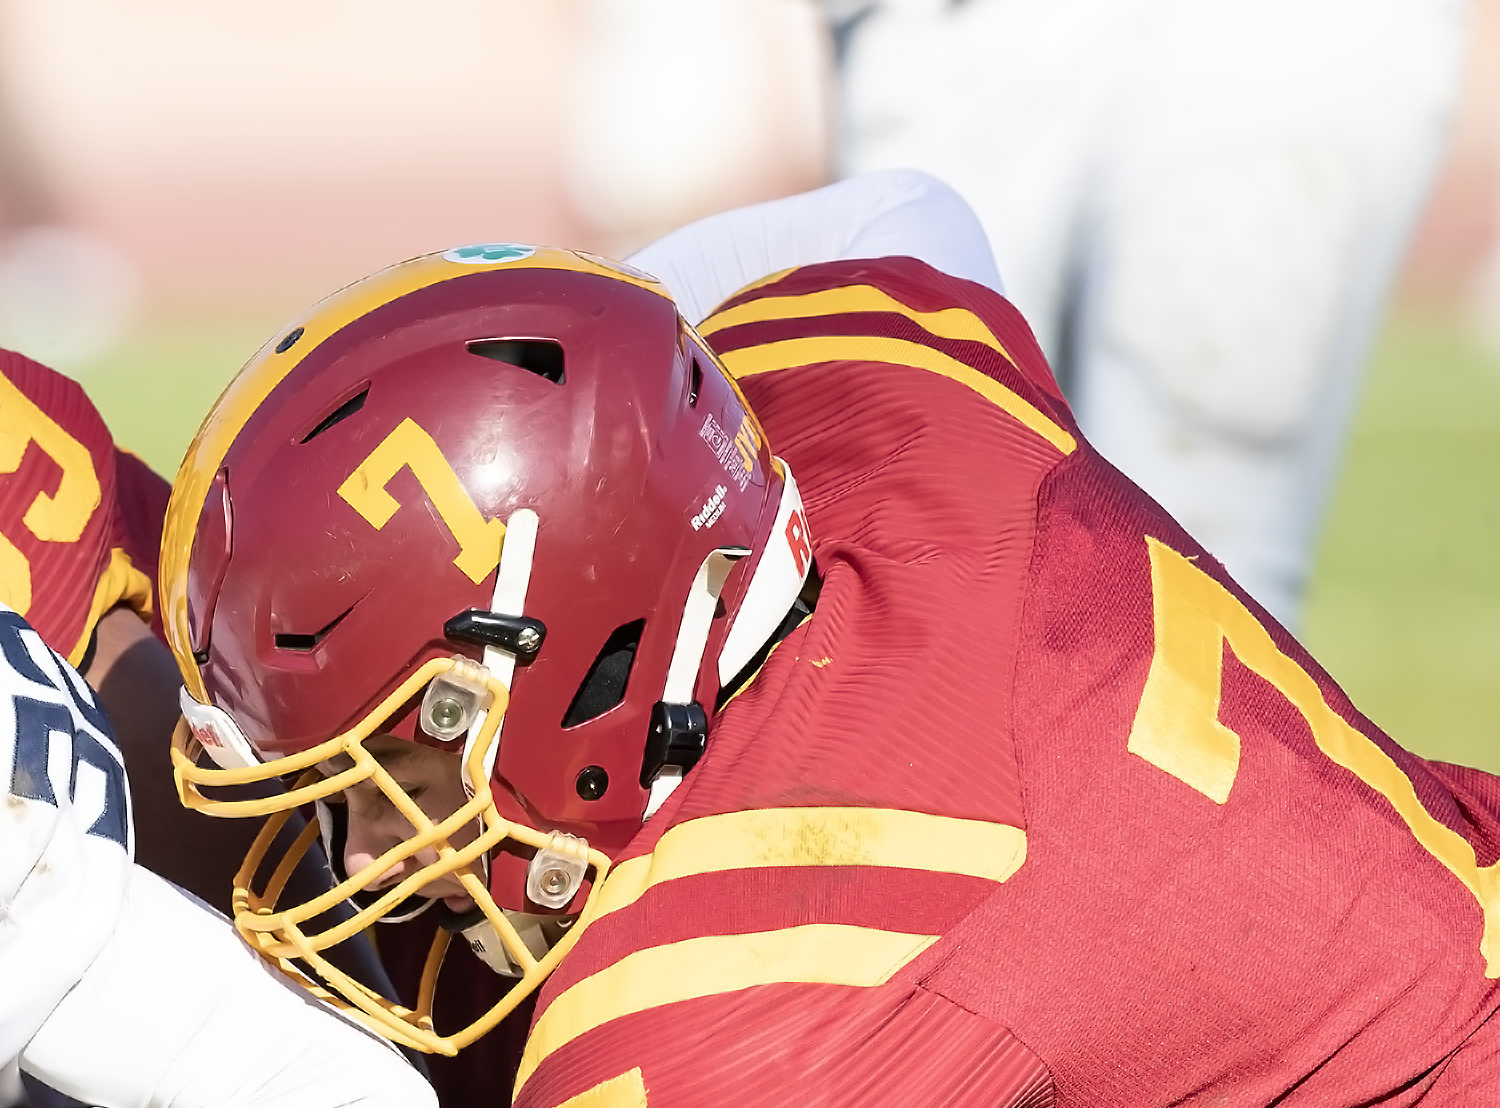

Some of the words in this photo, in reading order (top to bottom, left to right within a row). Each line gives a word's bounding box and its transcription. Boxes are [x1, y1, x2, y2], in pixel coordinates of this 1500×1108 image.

[336, 416, 507, 586] 7
[690, 484, 728, 532] Riddell
[1127, 534, 1500, 980] 7
